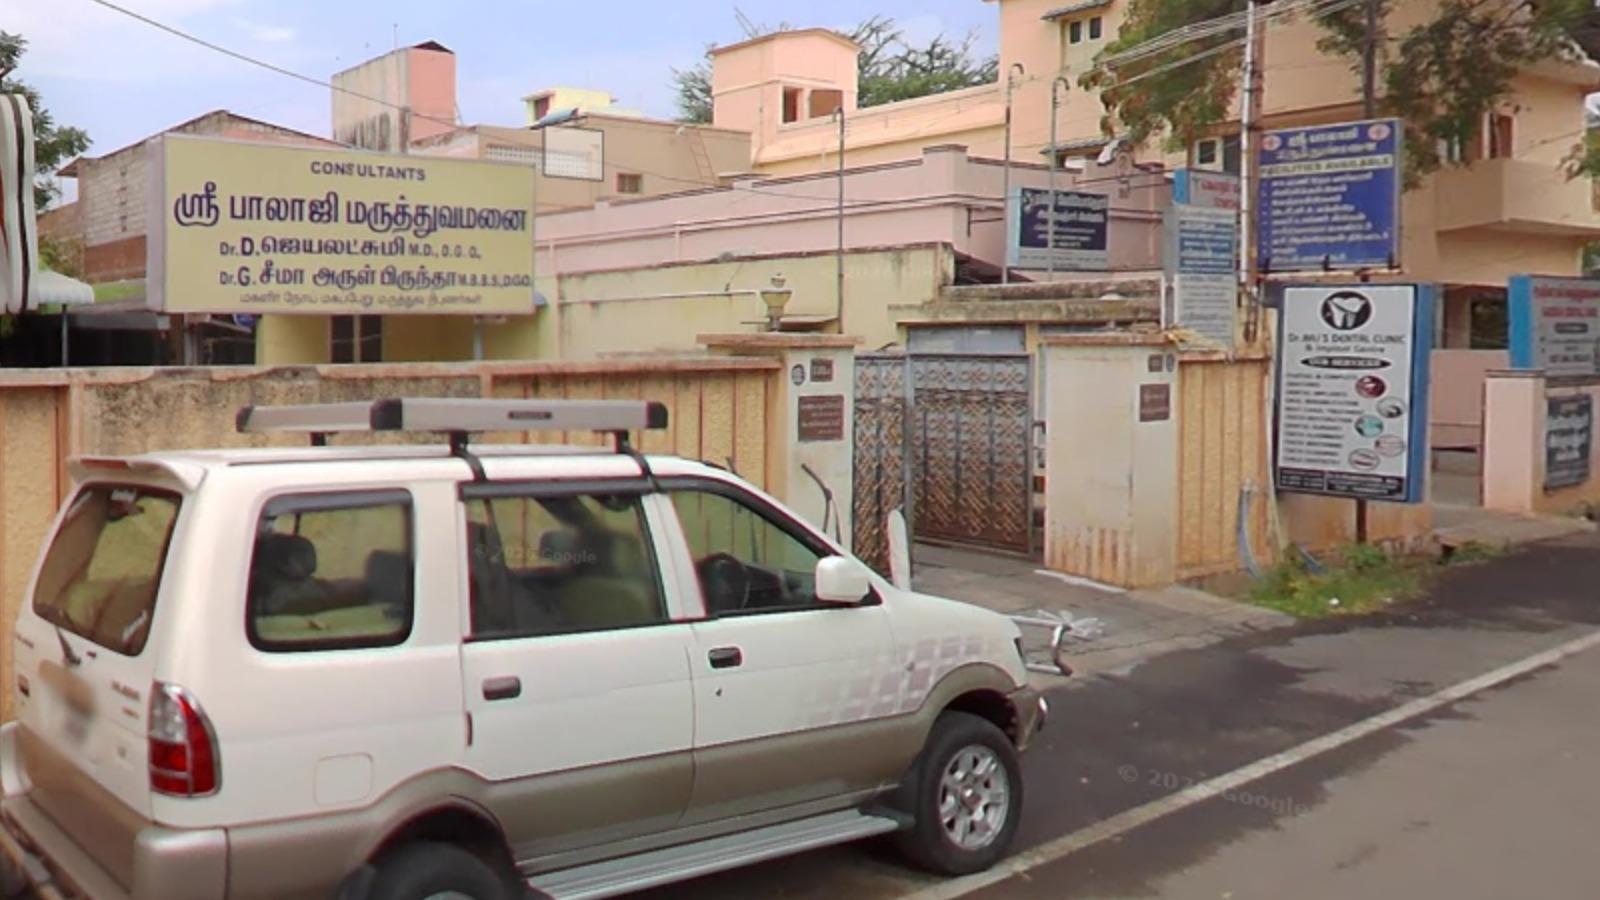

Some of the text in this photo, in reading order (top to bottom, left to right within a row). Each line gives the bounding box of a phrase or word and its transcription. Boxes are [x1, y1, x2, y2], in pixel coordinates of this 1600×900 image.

[310, 160, 427, 181] CONSULTANTS
[229, 191, 340, 223] பாலாஜி
[345, 195, 527, 238] மருத்துவமனை
[312, 263, 377, 290] அருள்
